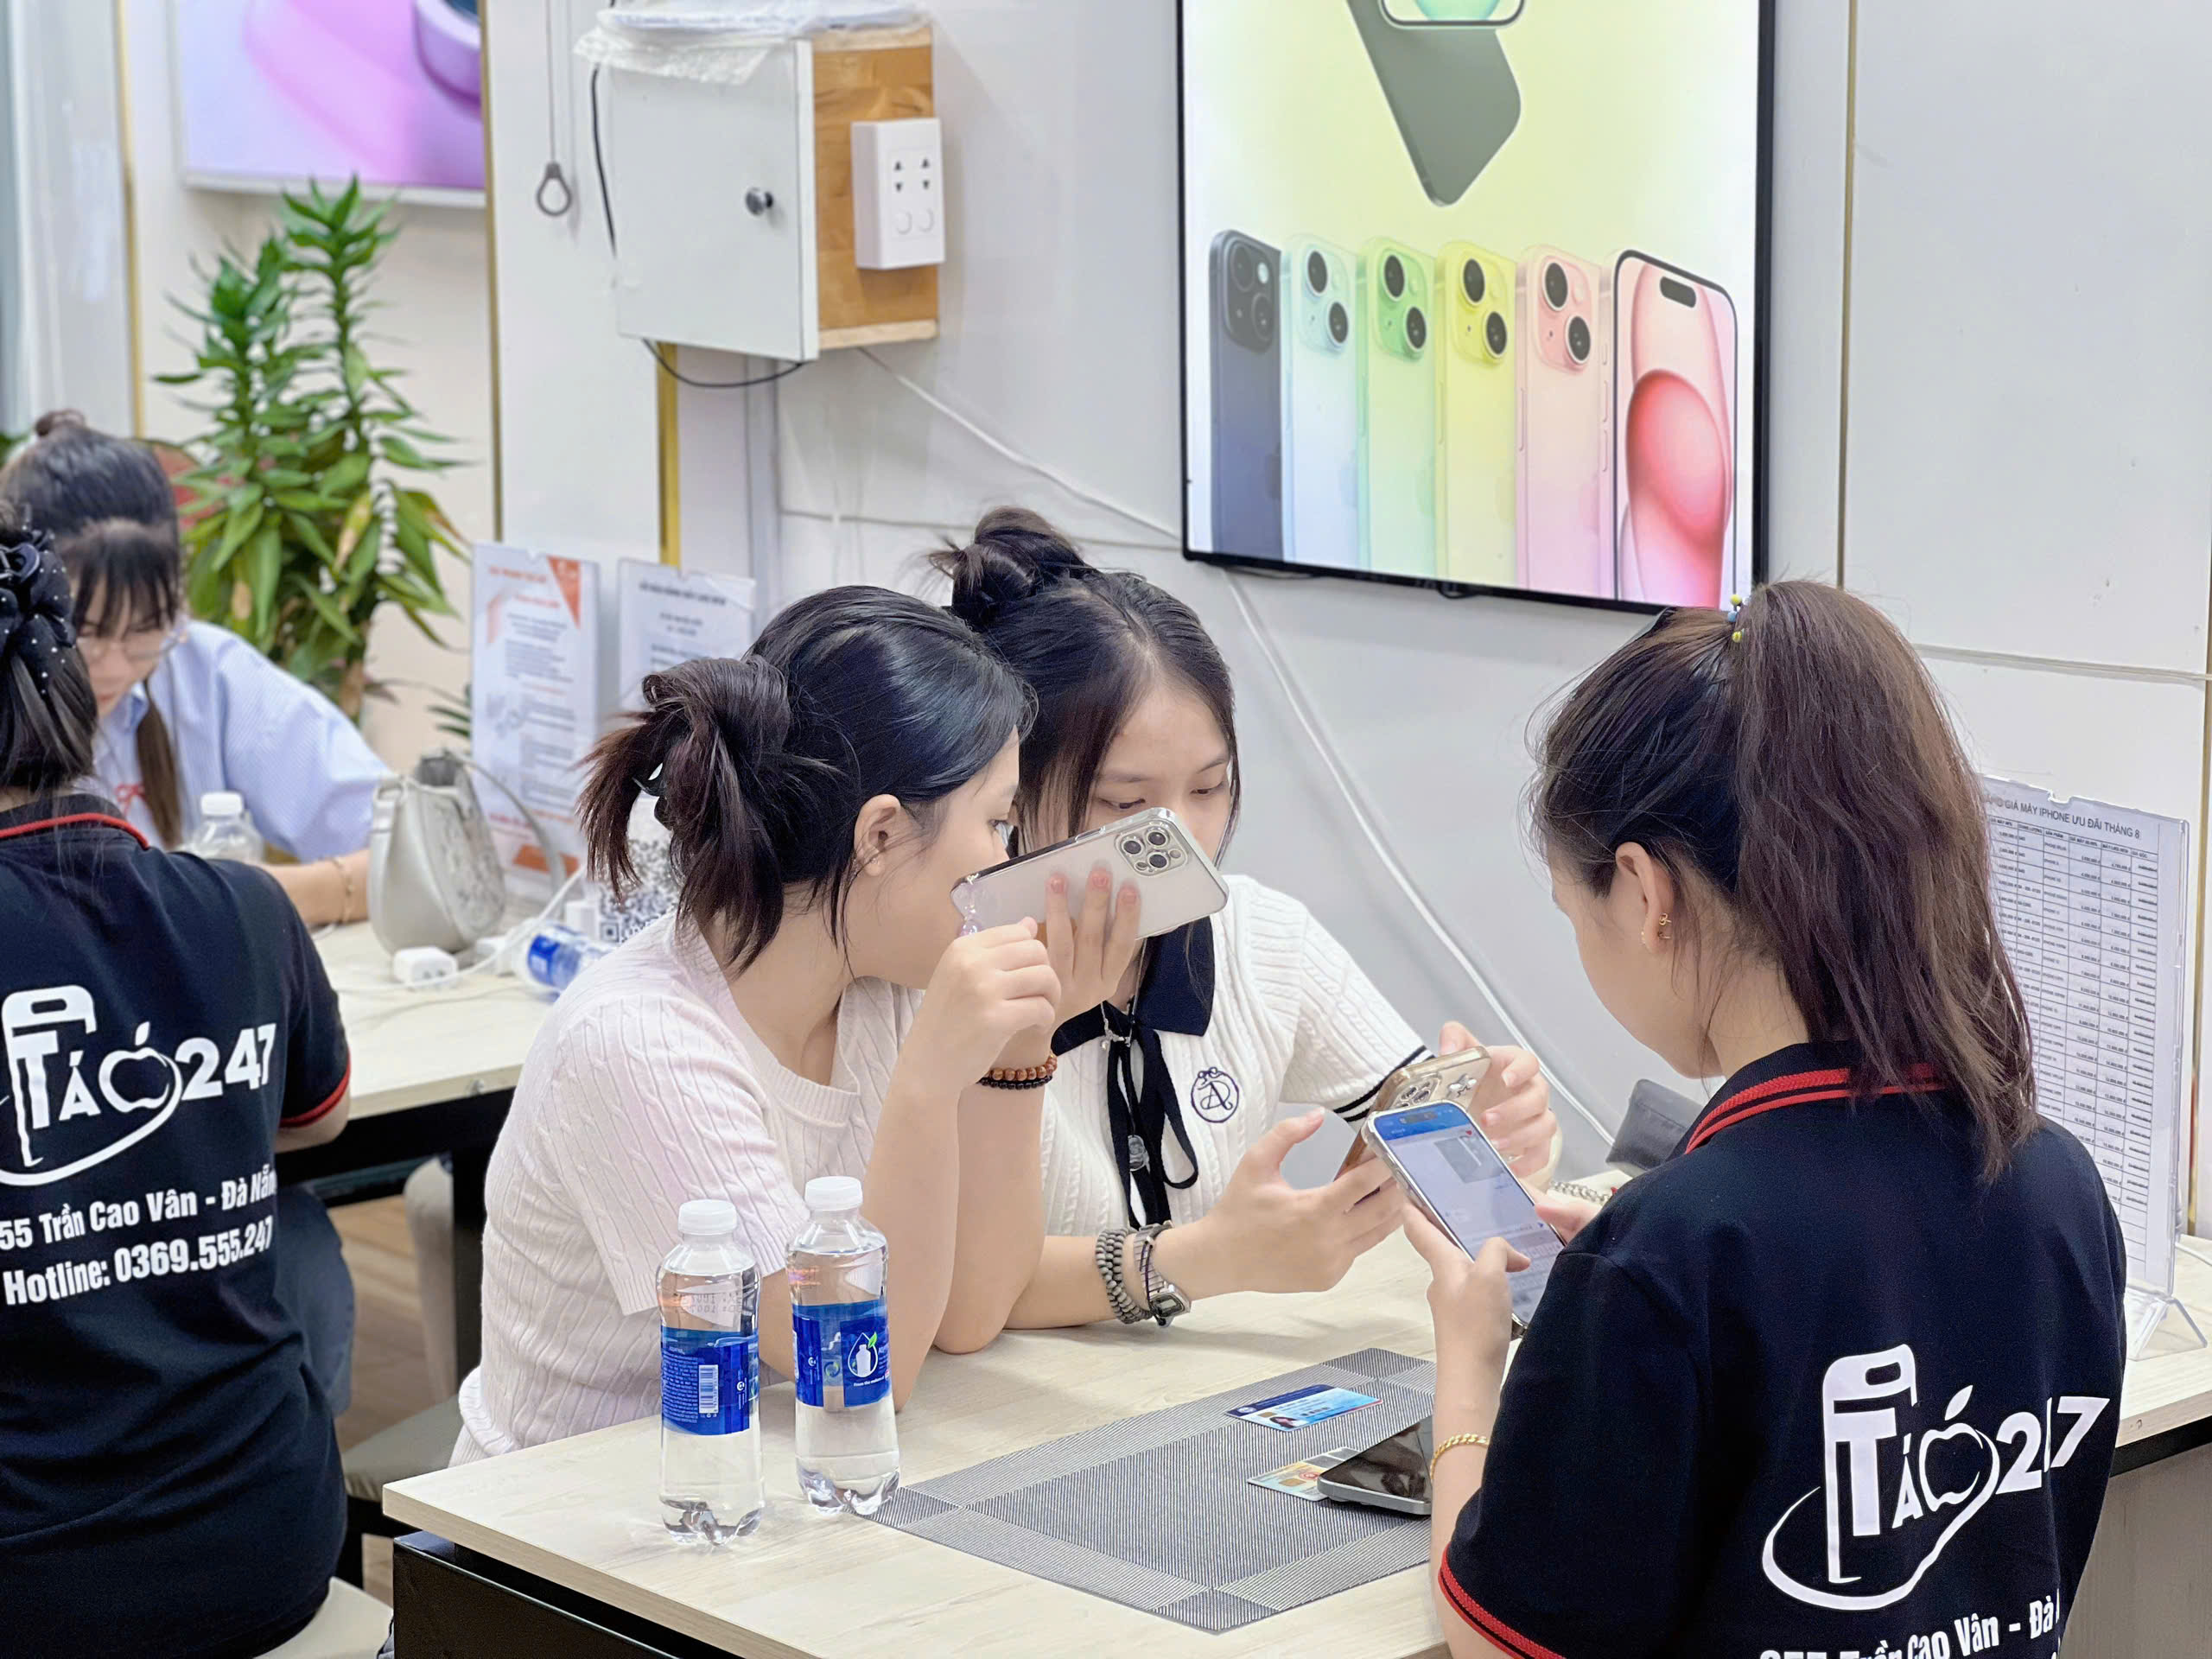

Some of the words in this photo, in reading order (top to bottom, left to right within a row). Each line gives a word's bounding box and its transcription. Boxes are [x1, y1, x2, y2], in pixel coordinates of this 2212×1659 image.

[2039, 808, 2070, 823] IPHONE
[2134, 829, 2140, 839] 8
[39, 1203, 86, 1244] Trần
[89, 1199, 139, 1232] Cao
[146, 1189, 198, 1223] Vân
[221, 1177, 248, 1211] Đà
[3, 1259, 111, 1306] Hotline:
[115, 1215, 274, 1283] 0369.555.247
[1954, 1612, 2000, 1657] Vân
